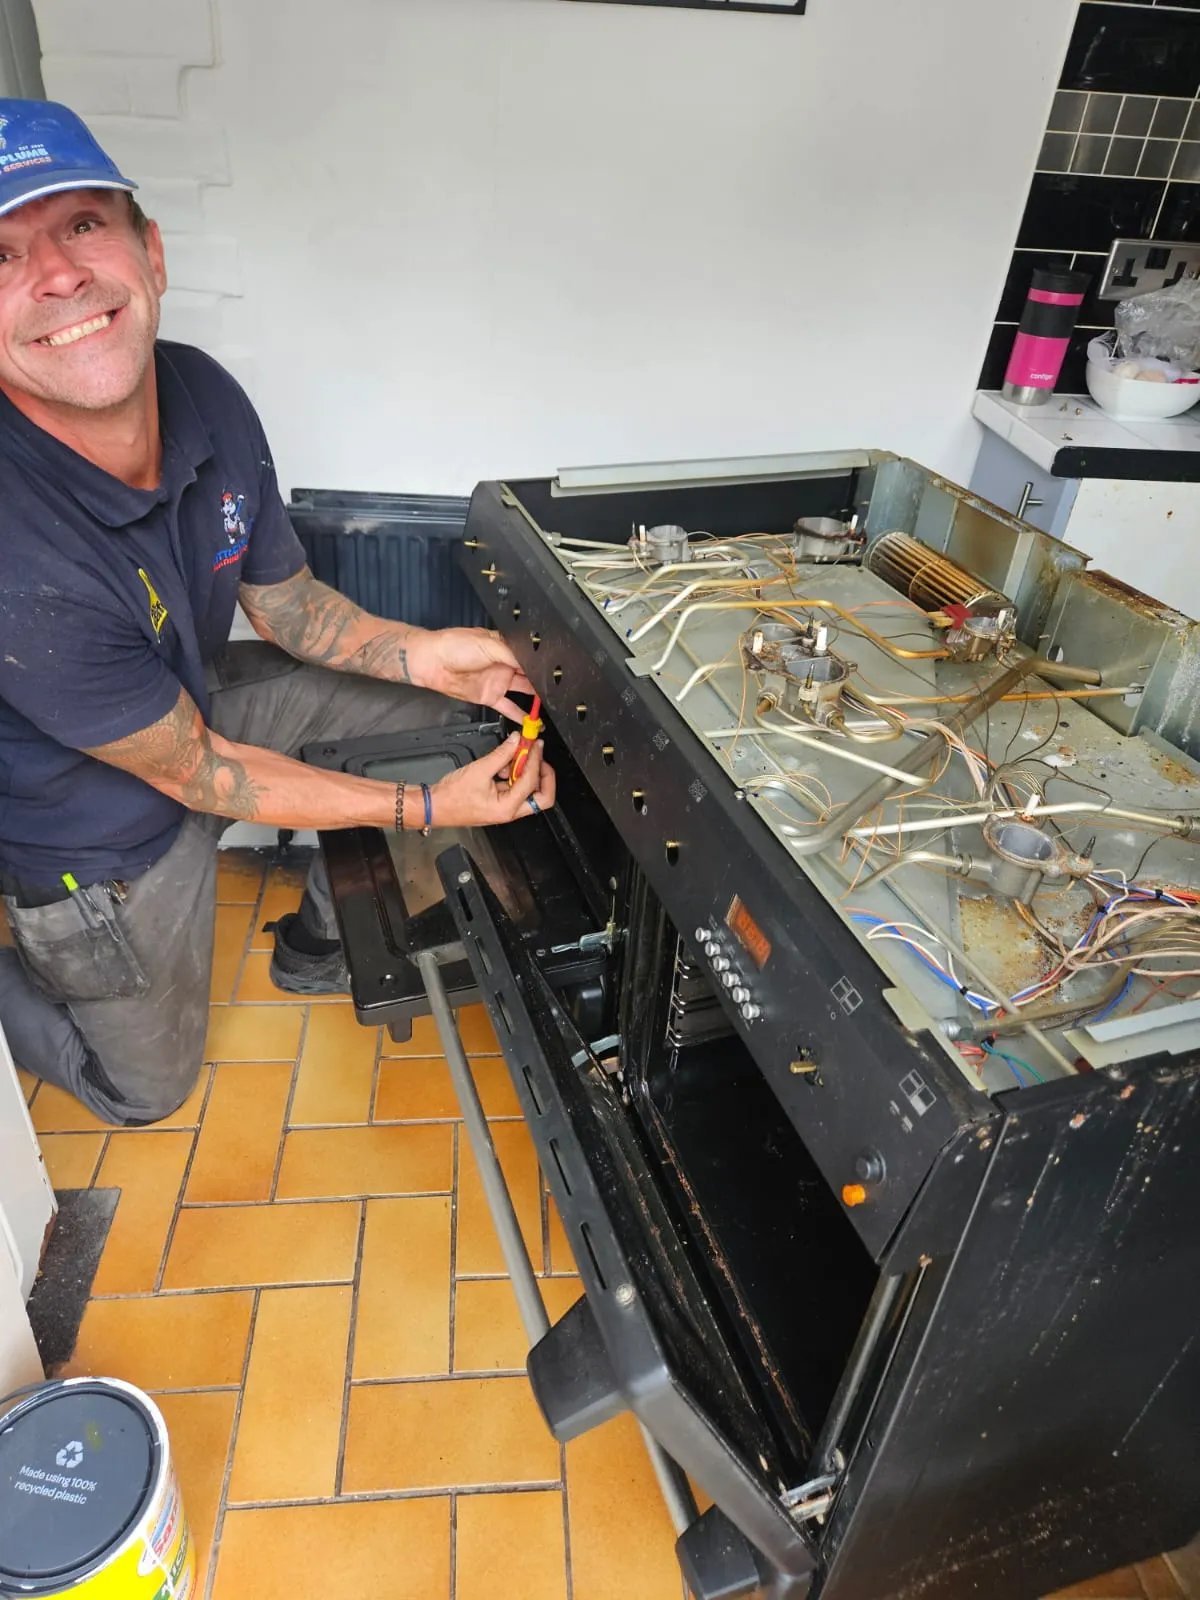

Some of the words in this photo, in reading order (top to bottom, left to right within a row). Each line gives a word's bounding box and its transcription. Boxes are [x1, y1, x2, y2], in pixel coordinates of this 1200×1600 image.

[0, 148, 48, 165] PLUMB
[3, 156, 52, 172] SERVICES
[19, 1465, 46, 1480] Made
[45, 1473, 71, 1488] using
[71, 1478, 97, 1491] 100%
[14, 1481, 57, 1497] recycled
[53, 1489, 87, 1504] plastic
